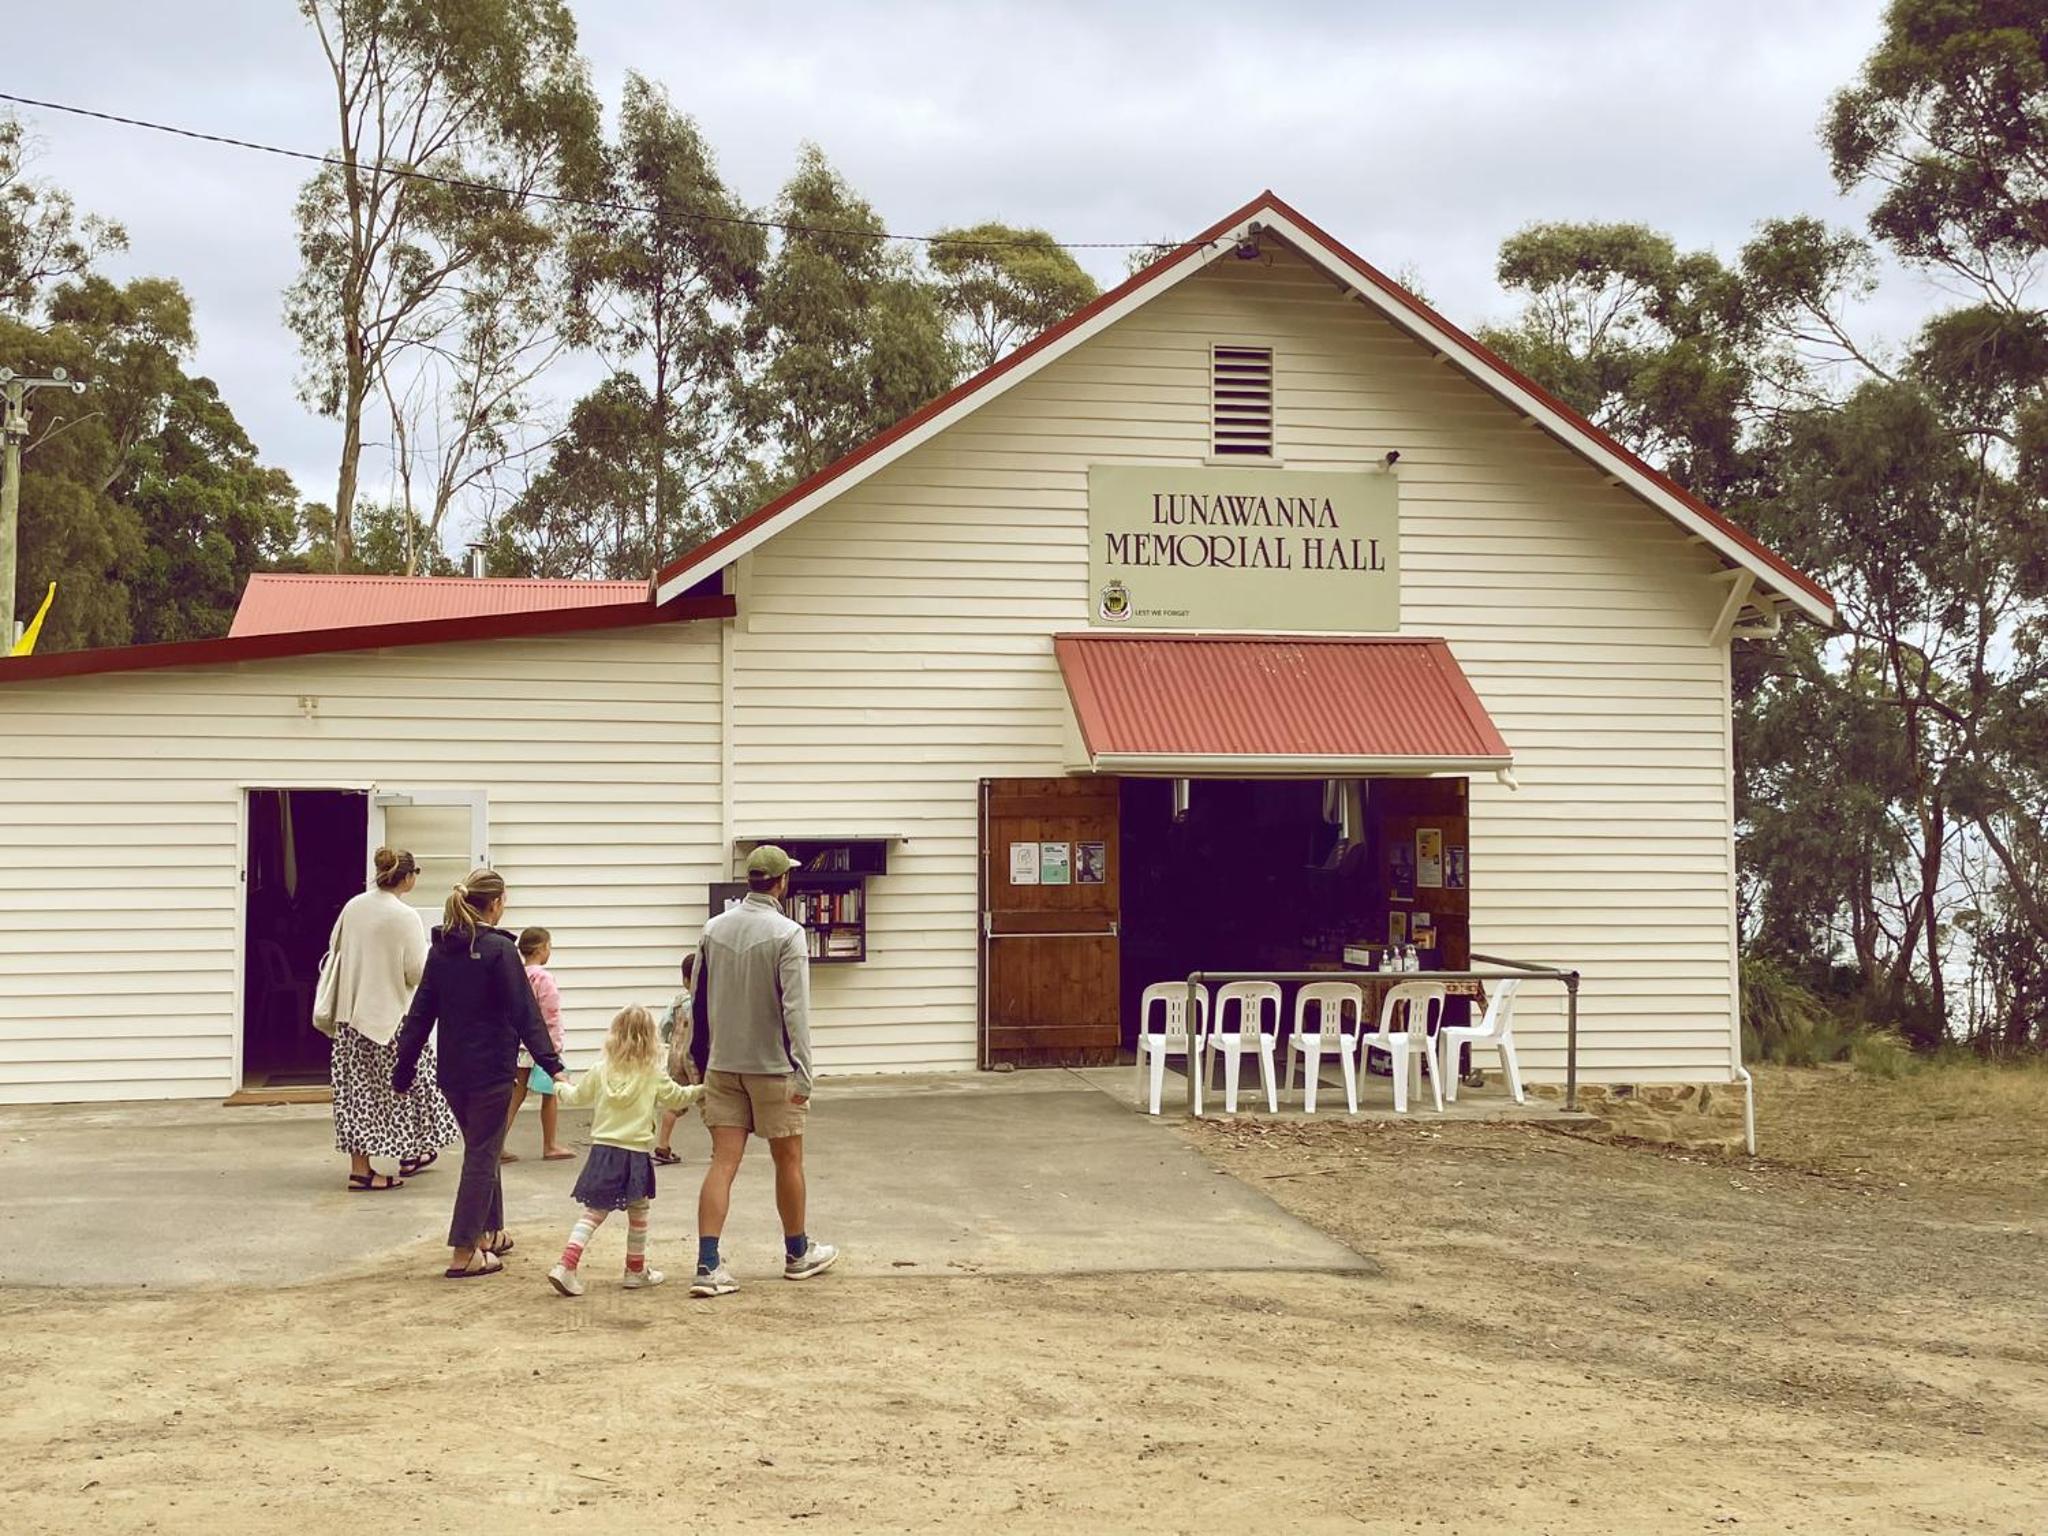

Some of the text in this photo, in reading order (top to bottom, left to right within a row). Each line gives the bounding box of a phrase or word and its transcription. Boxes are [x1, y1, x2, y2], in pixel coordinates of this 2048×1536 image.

[1152, 493, 1339, 528] LUNAWANNA
[1105, 533, 1386, 571] MEMORIAL HALL
[1135, 609, 1190, 617] LEST WE FORGET
